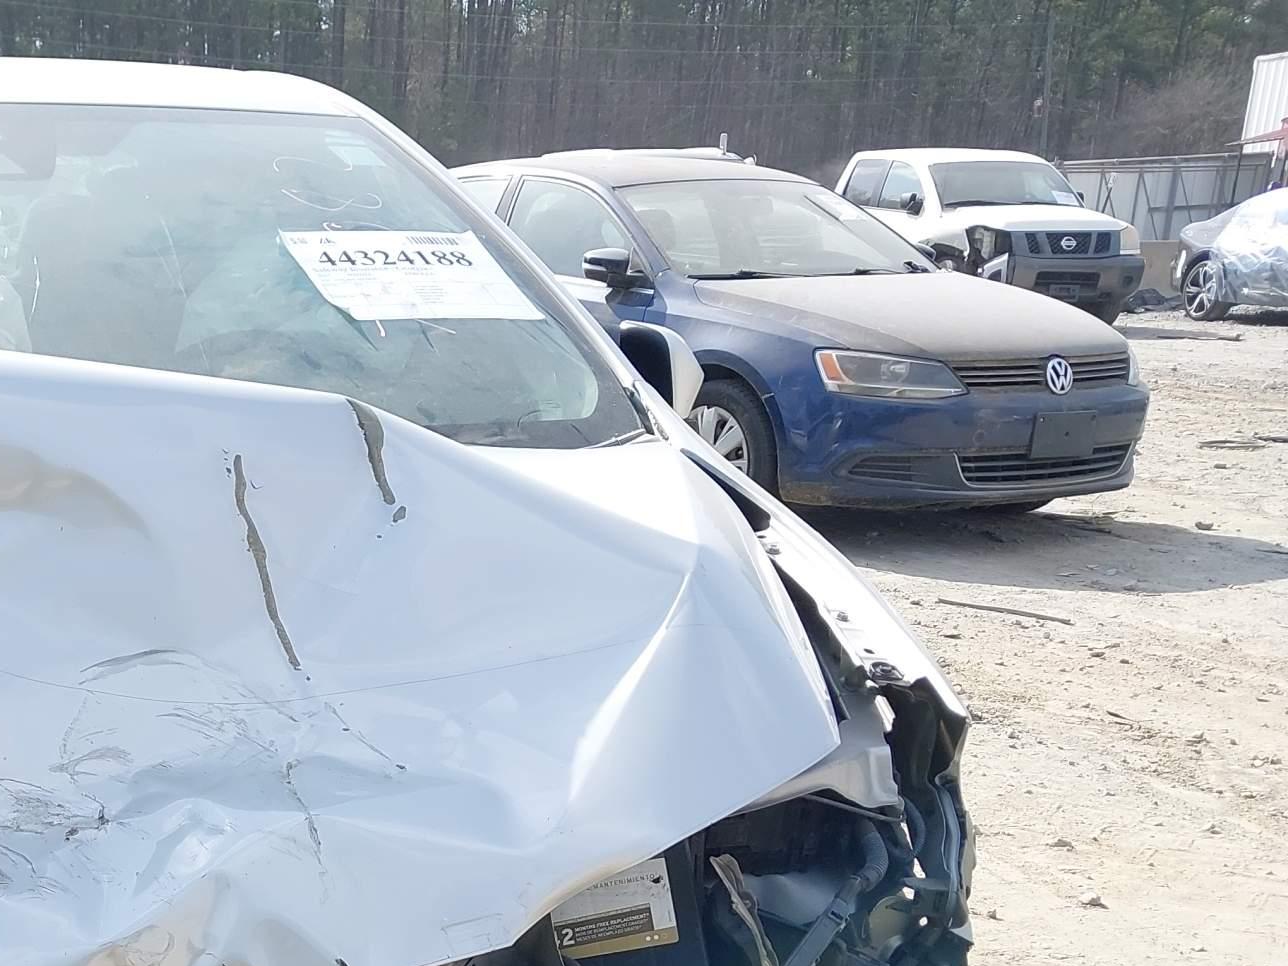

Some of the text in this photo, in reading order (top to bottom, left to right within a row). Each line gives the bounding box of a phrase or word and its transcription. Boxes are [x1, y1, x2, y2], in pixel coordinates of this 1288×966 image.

[319, 250, 473, 267] 44324188
[593, 873, 655, 889] MANTENIMIENTO
[574, 924, 596, 933] MONTHS
